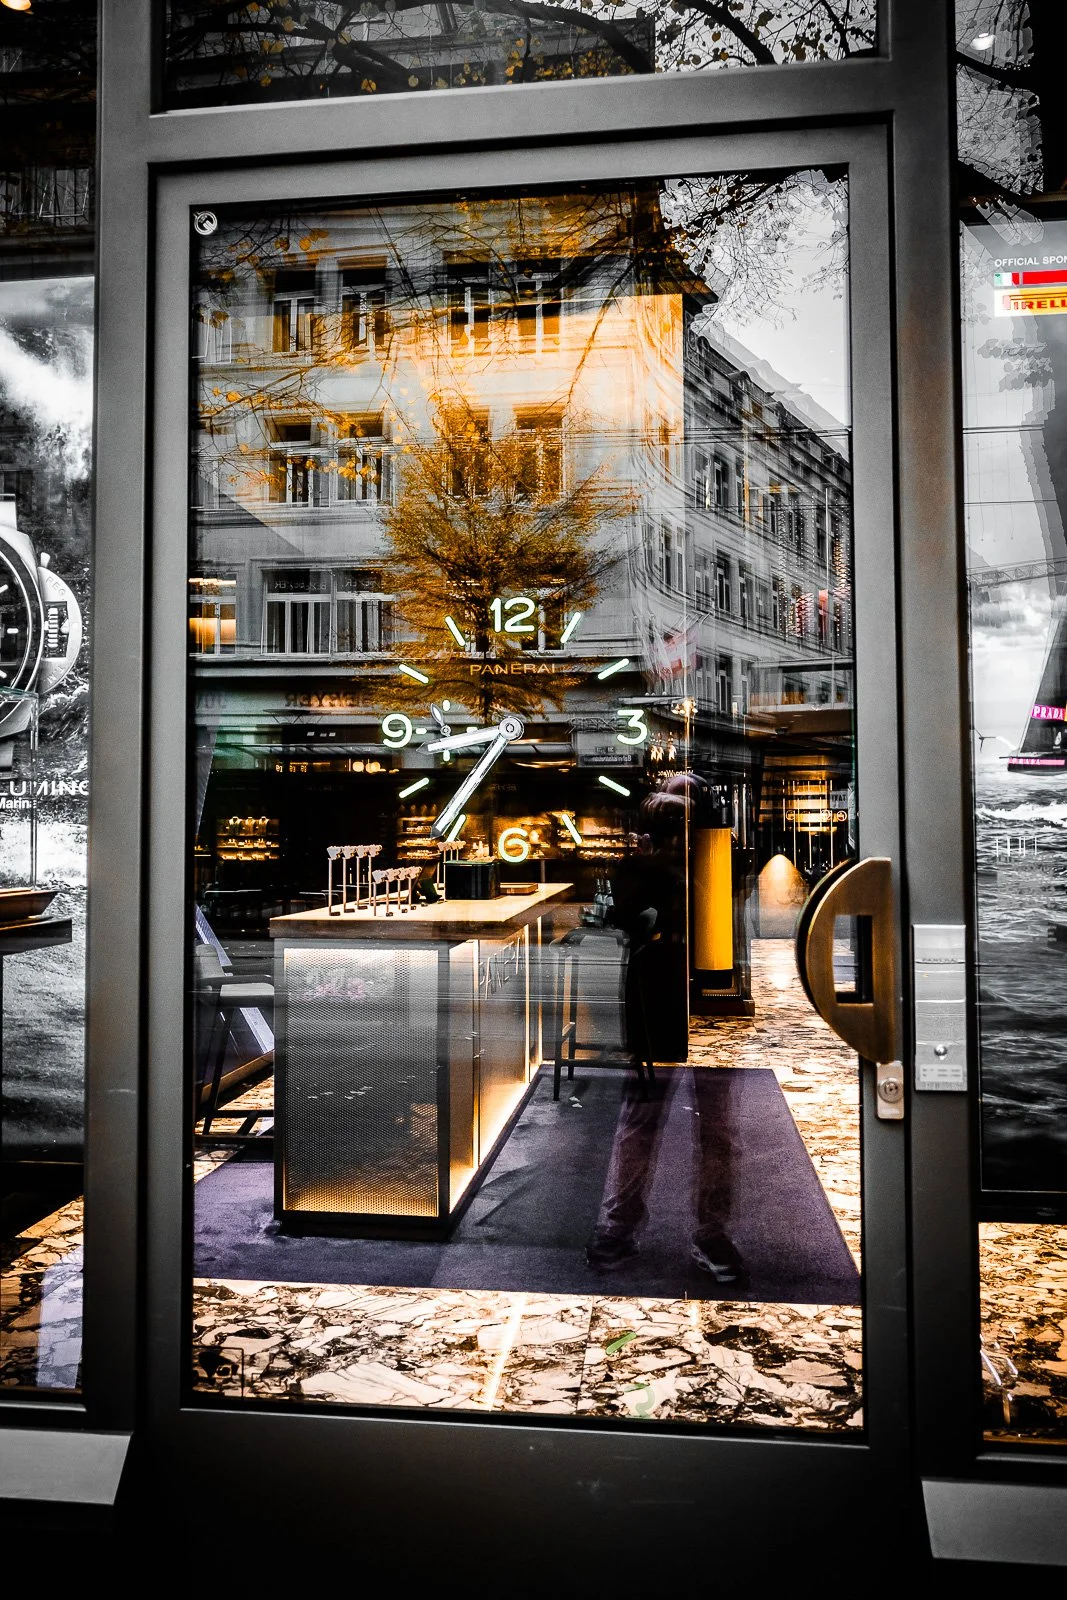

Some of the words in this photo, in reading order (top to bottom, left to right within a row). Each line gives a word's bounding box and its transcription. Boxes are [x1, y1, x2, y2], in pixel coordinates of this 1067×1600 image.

[994, 257, 1039, 267] OFFICIAL
[490, 597, 536, 633] 12
[469, 663, 555, 676] PANERAI
[616, 709, 648, 745] 3
[1032, 705, 1064, 719] PRADA
[382, 713, 412, 748] 9
[498, 828, 529, 863] 6
